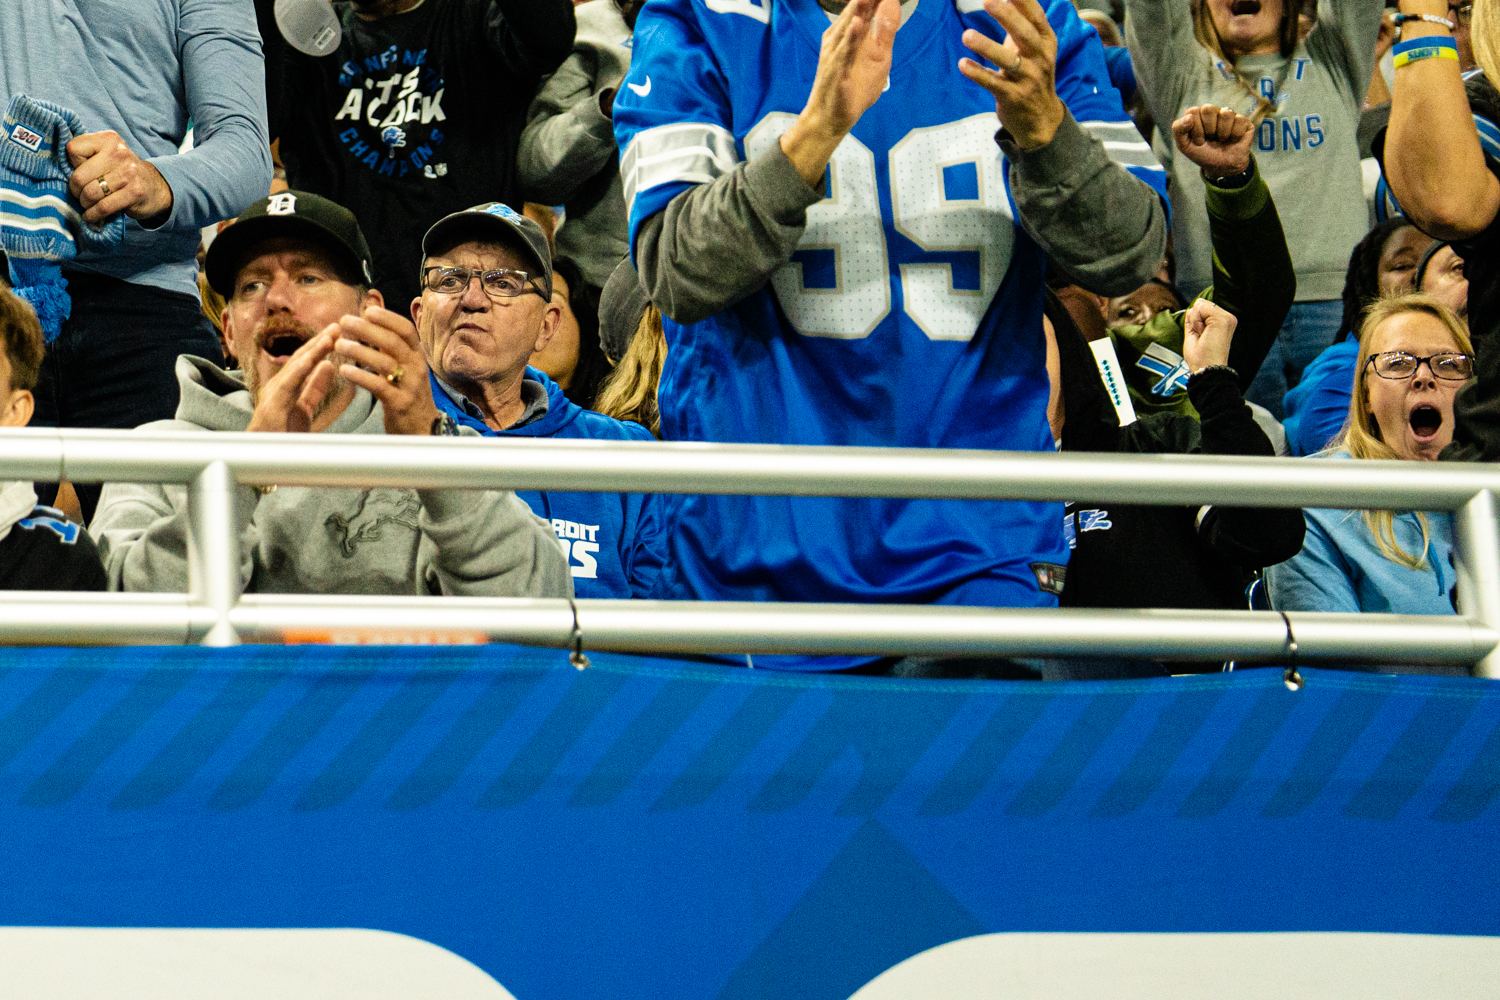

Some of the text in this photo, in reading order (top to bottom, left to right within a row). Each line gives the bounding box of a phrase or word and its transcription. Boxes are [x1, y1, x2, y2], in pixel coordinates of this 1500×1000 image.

[334, 88, 363, 120] A
[1257, 113, 1325, 152] ONS
[743, 110, 1016, 342] 99
[552, 518, 600, 542] ROIT
